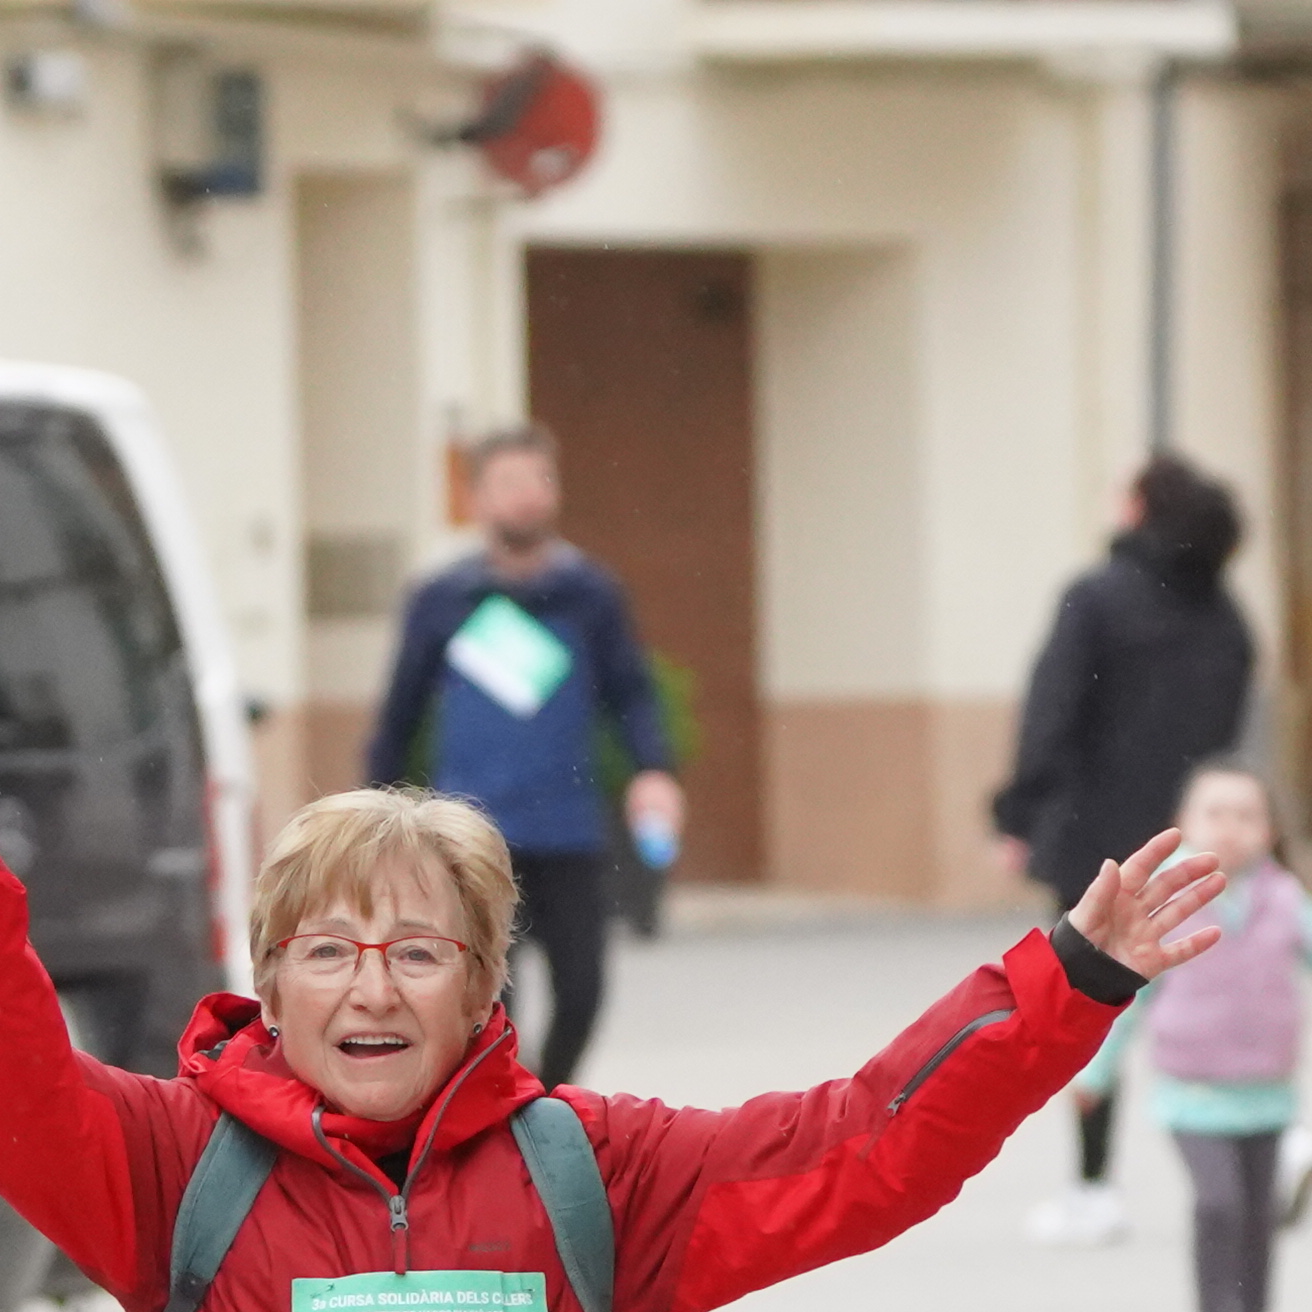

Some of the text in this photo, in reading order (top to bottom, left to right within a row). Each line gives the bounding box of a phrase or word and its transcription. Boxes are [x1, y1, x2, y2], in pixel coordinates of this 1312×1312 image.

[311, 1289, 533, 1311] 3a CURSA SOLIDÀRIA DELS CLERS
